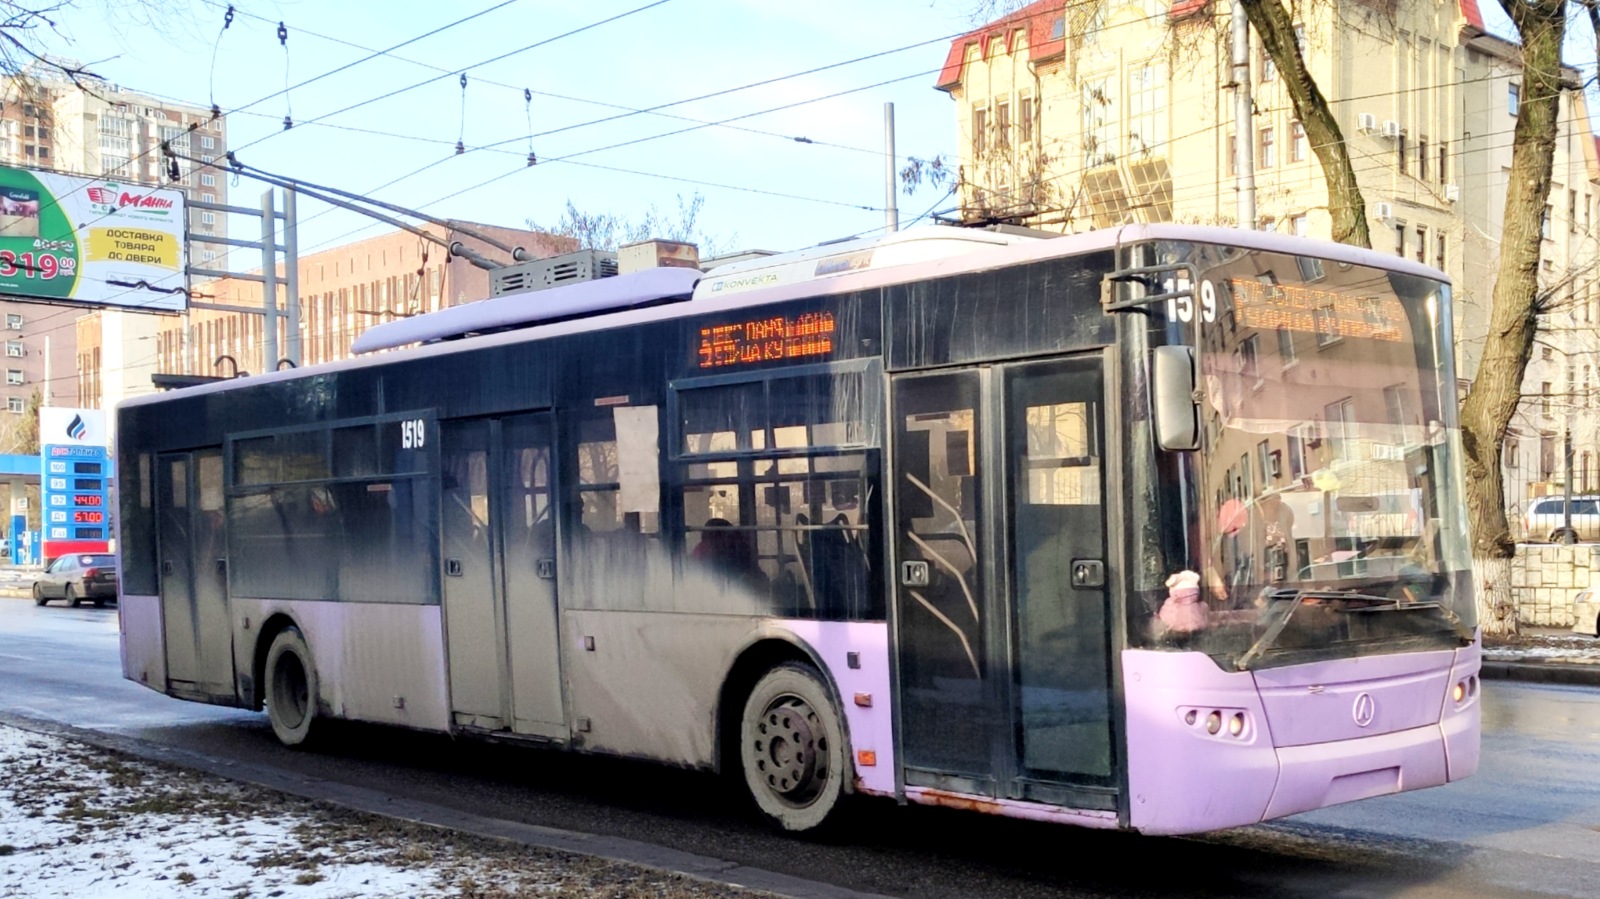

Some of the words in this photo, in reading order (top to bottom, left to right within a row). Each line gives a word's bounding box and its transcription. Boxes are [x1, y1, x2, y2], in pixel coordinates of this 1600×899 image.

[119, 192, 173, 209] МАННА
[106, 229, 163, 242] ДОСТАВКА
[114, 240, 155, 252] ТОВАРА
[0, 249, 59, 279] 319
[59, 256, 76, 269] 00
[125, 253, 162, 265] ДВЕРИ
[723, 274, 778, 290] KONVEKTA
[401, 419, 424, 448] 1519
[52, 463, 65, 471] 100
[52, 479, 64, 488] 95
[53, 495, 64, 504] 92
[74, 495, 102, 505] 44.00
[74, 511, 103, 522] 57.00
